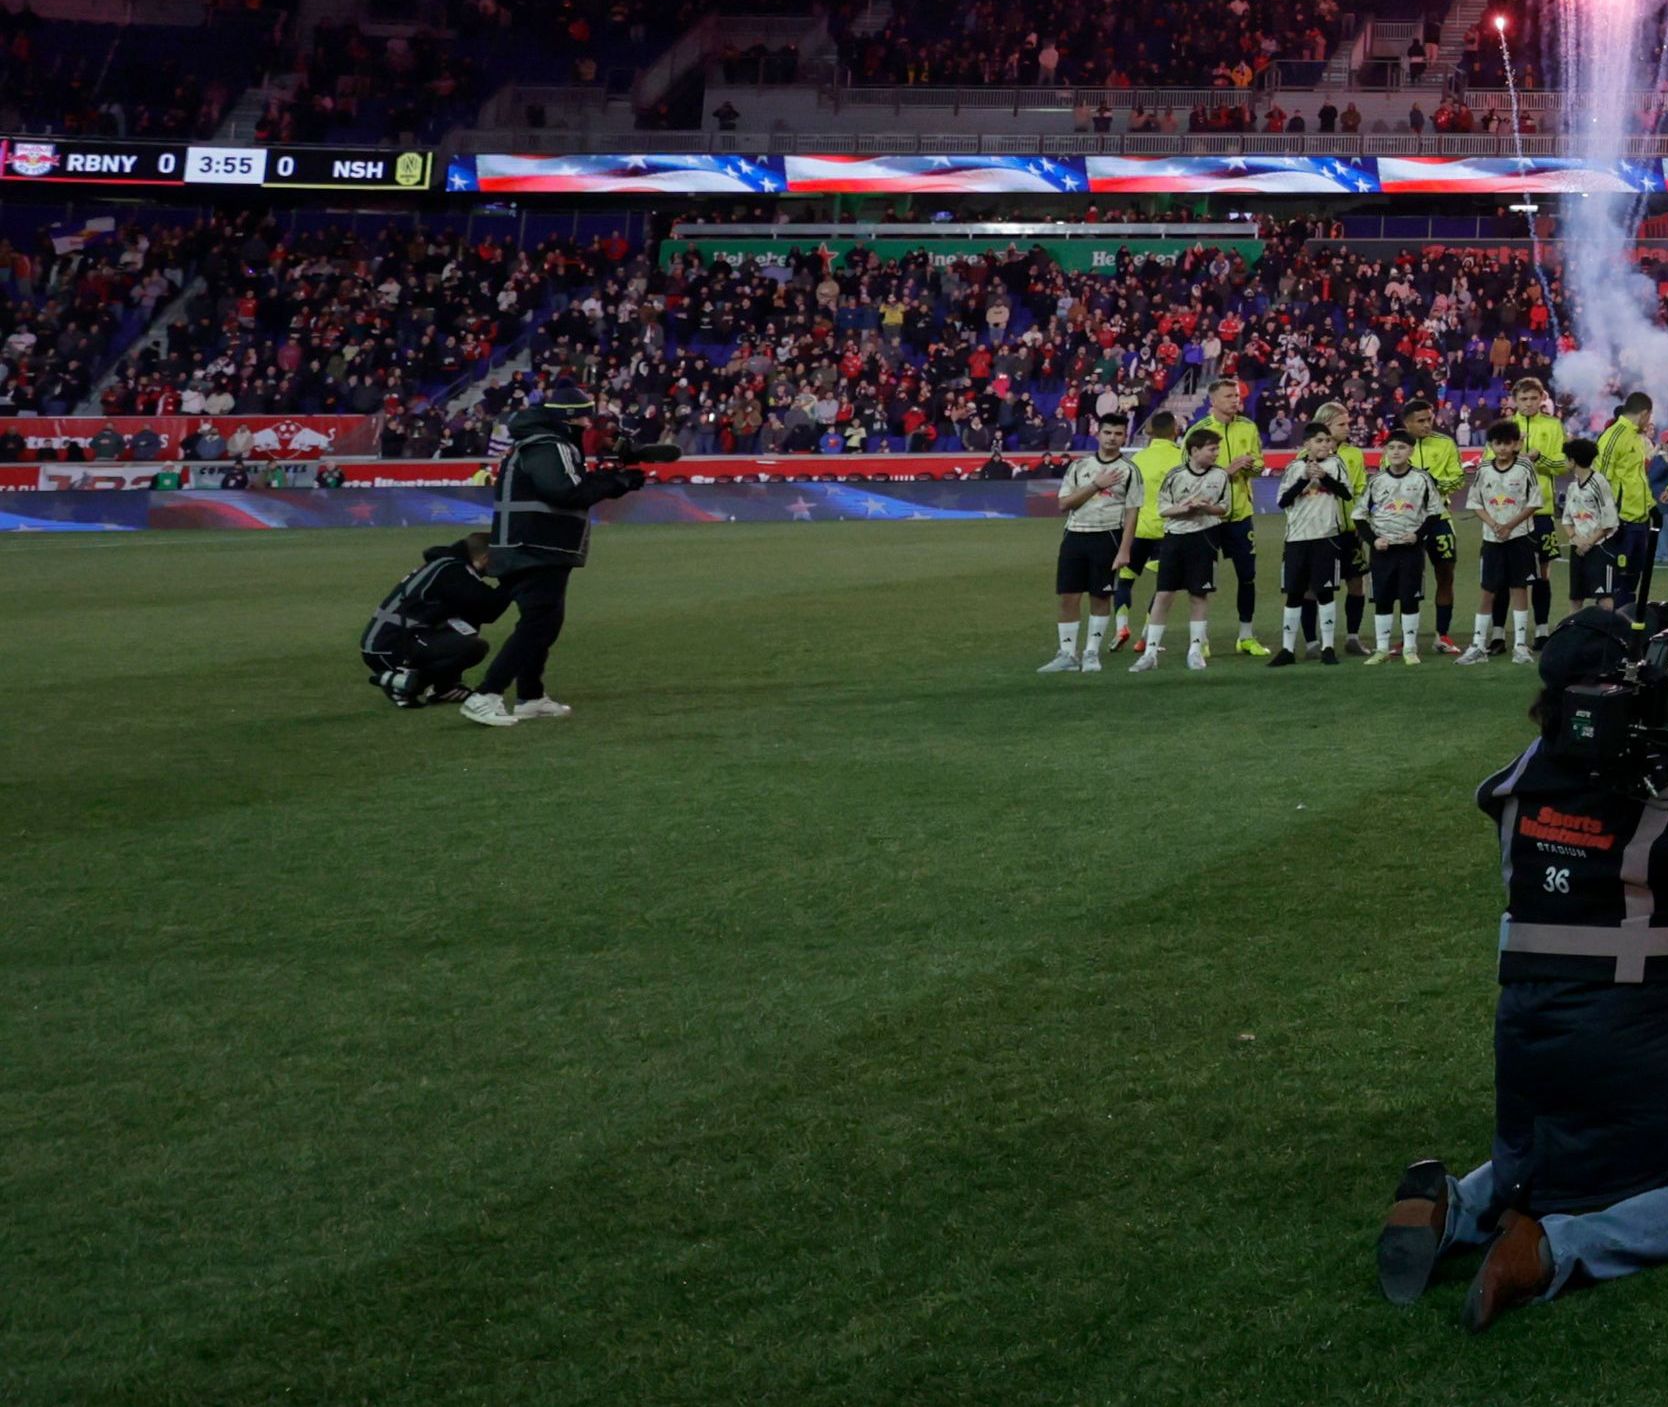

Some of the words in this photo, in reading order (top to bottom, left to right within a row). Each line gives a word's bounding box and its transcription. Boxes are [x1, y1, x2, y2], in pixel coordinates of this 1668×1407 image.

[66, 153, 138, 173] RBNY
[157, 153, 176, 174] 0
[198, 155, 253, 175] 3:55
[276, 156, 294, 177] 0
[332, 160, 384, 179] NSH
[1436, 535, 1455, 553] 31
[1536, 841, 1588, 859] STADIUM
[1542, 865, 1571, 894] 36
